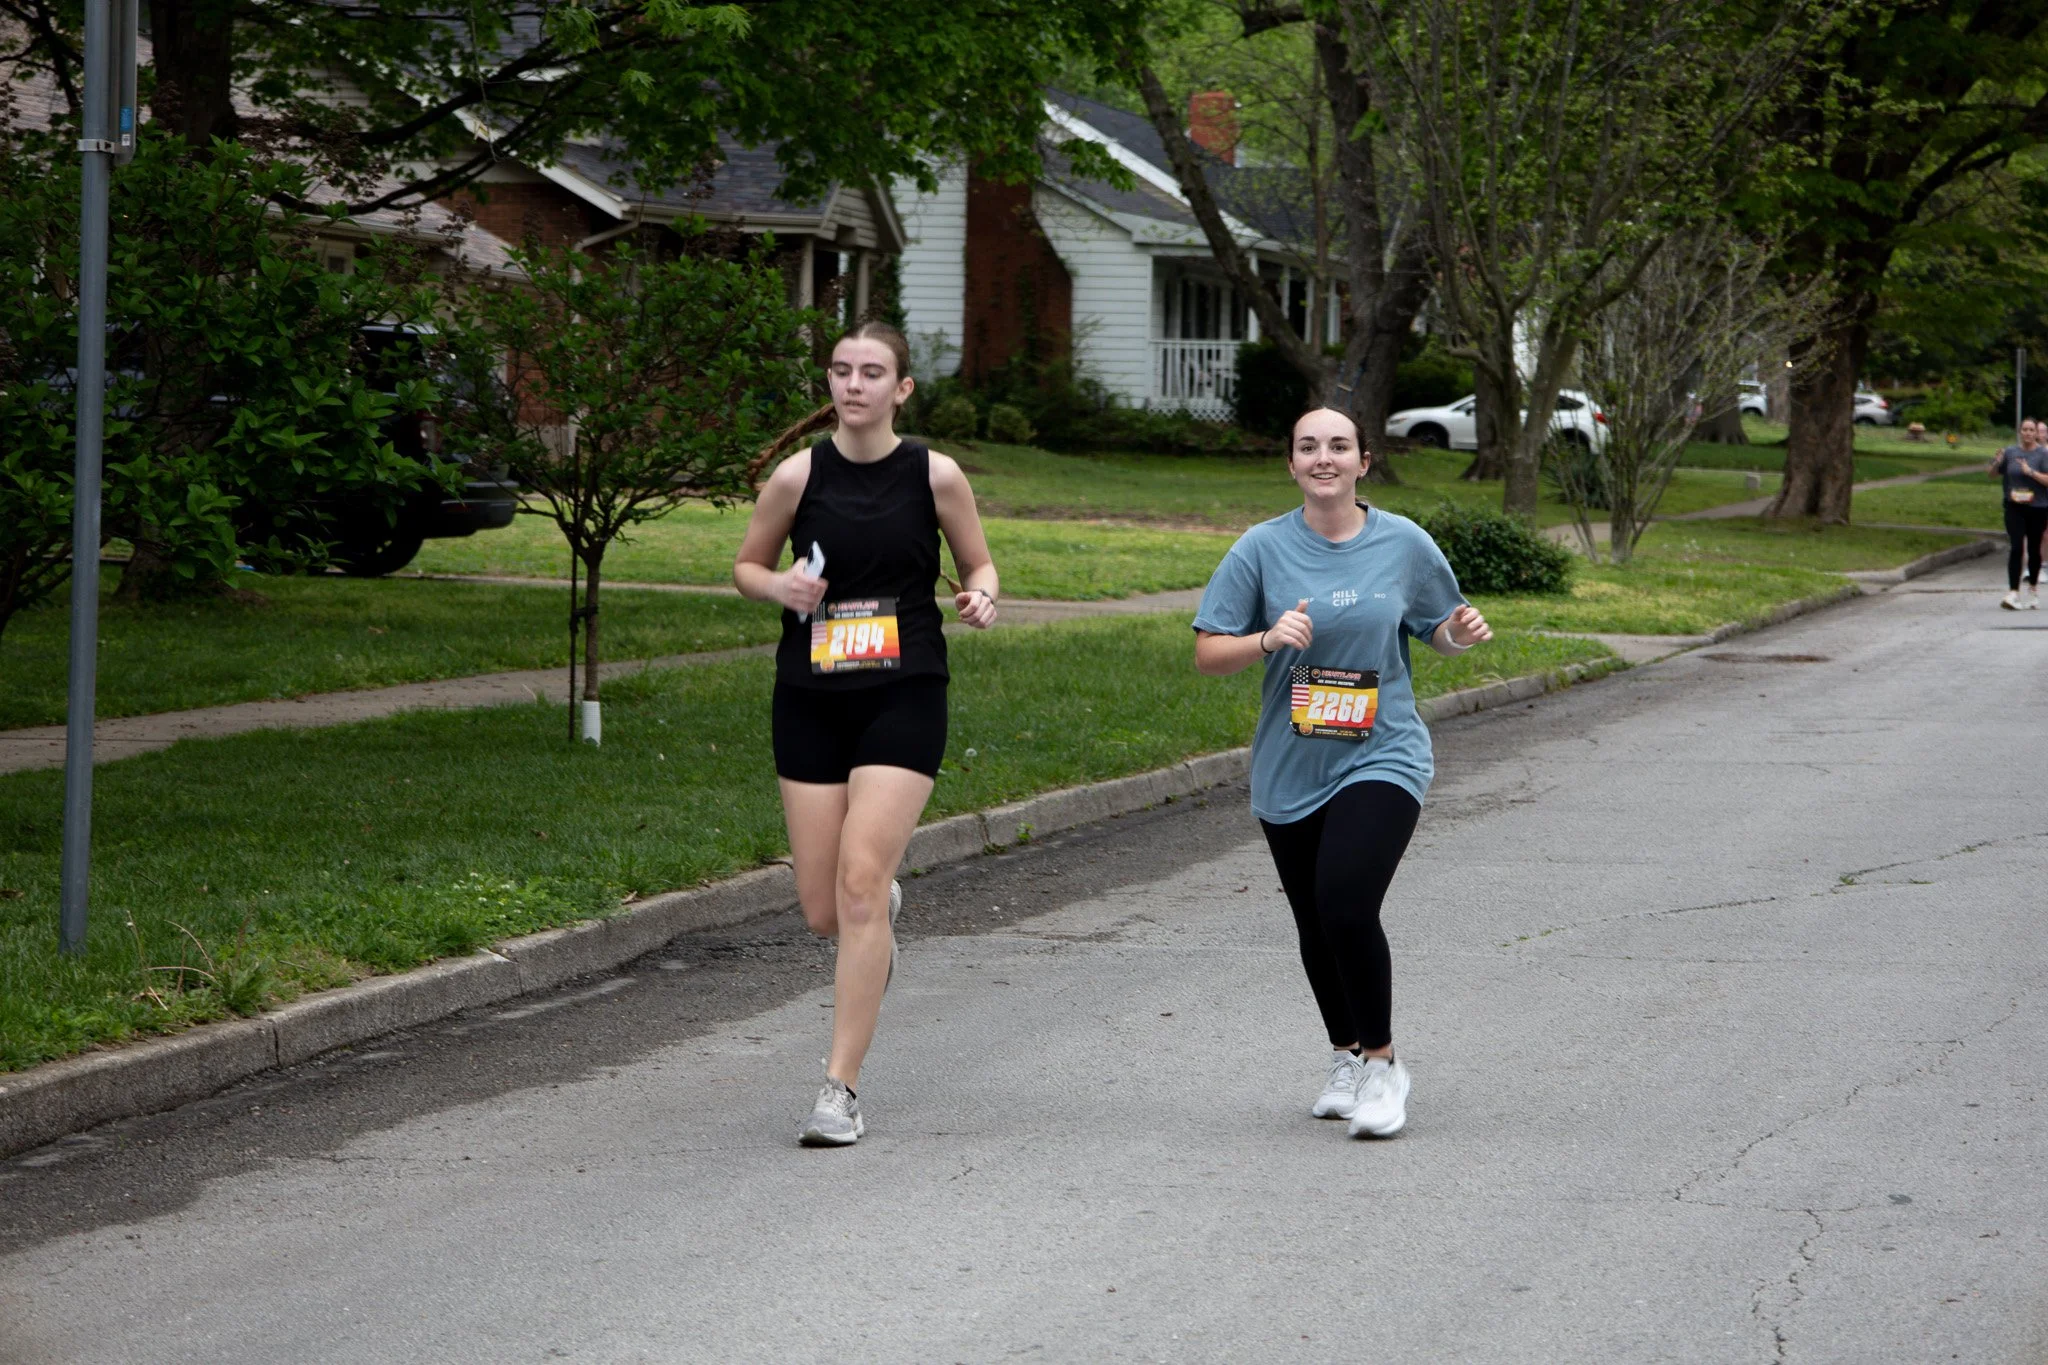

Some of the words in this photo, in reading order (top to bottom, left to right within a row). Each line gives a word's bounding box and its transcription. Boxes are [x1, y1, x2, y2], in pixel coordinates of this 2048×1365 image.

[1332, 589, 1358, 599] HILL
[1332, 598, 1357, 607] CITY
[829, 622, 884, 656] 2194
[1307, 691, 1368, 723] 2268
